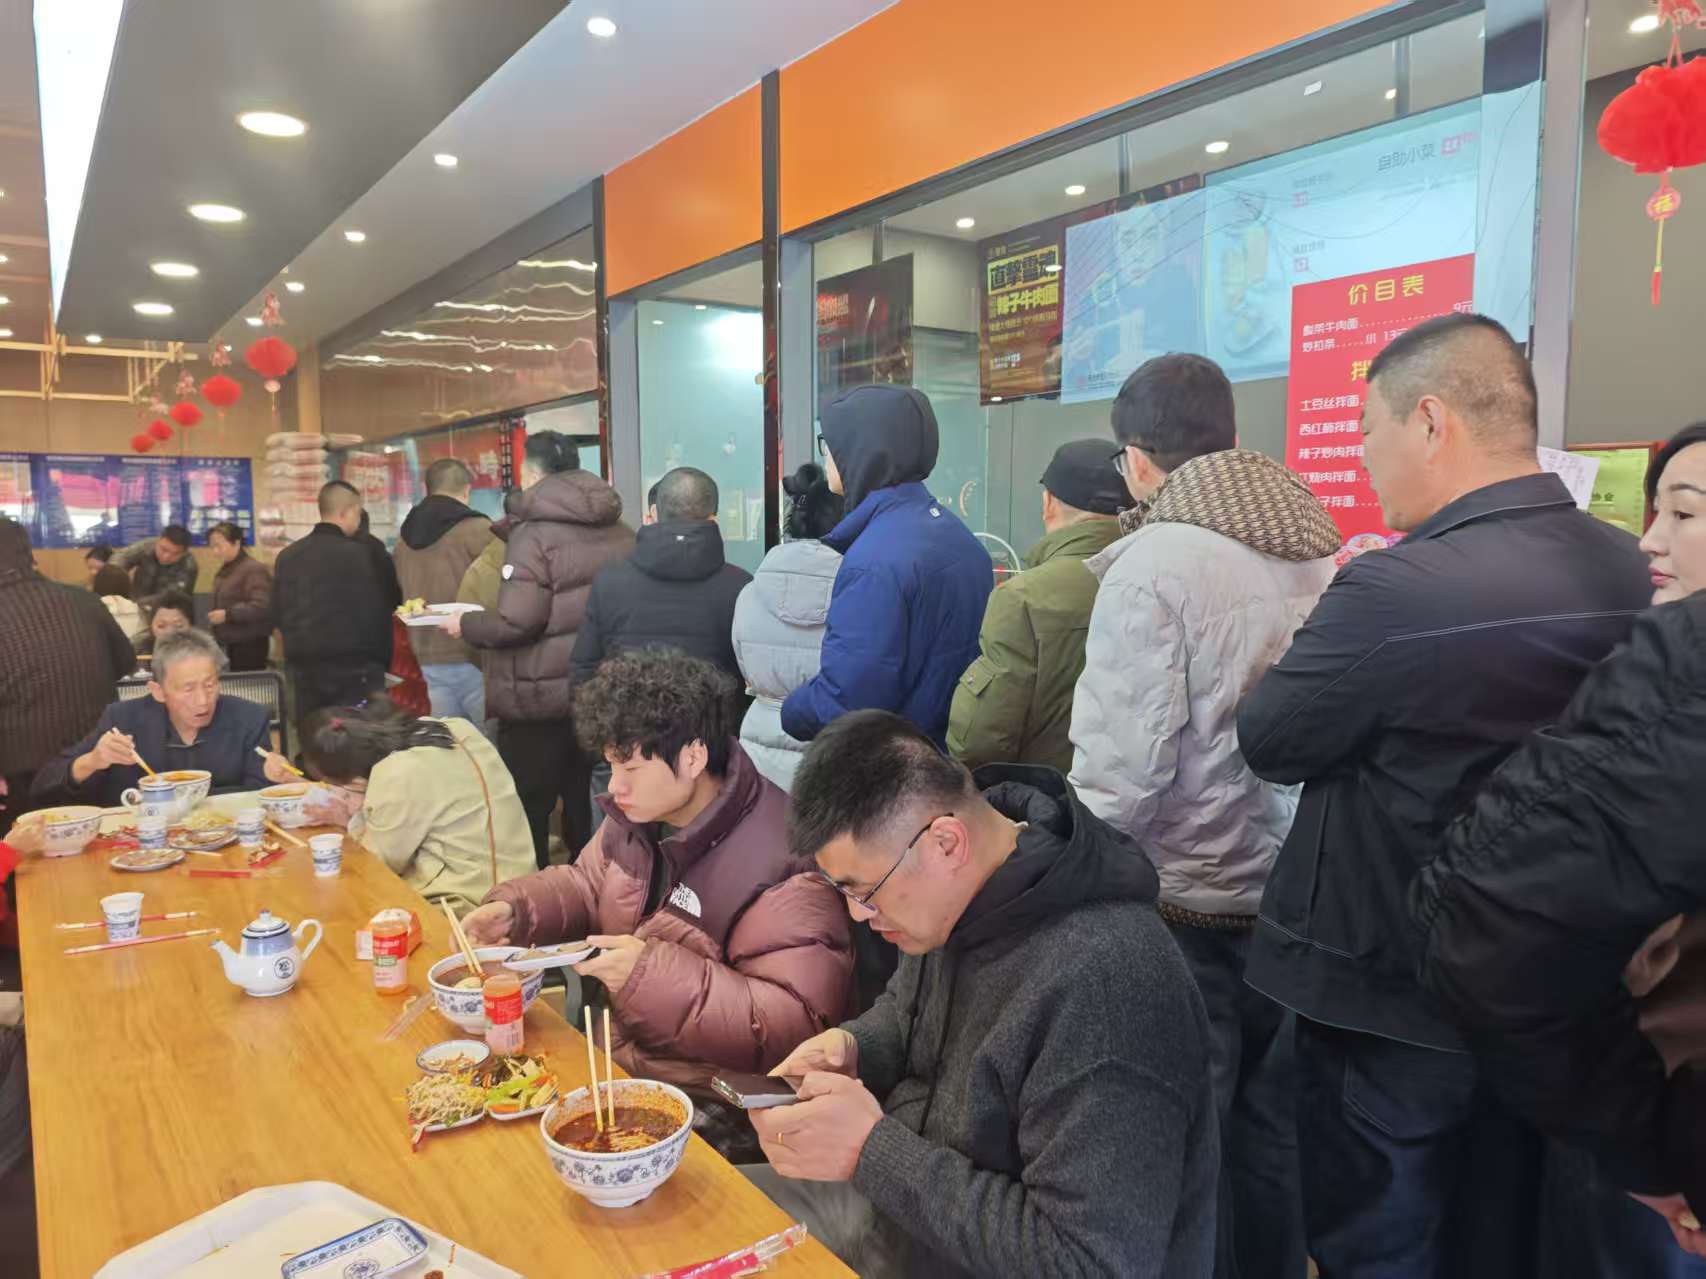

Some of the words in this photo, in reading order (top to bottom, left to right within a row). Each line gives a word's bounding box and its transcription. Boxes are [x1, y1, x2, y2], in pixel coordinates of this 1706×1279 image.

[1349, 274, 1424, 305] 价目表
[1300, 394, 1360, 412] 土豆丝拌面
[1299, 419, 1359, 436] 西红柿拌面
[1317, 494, 1355, 508] 子拌面
